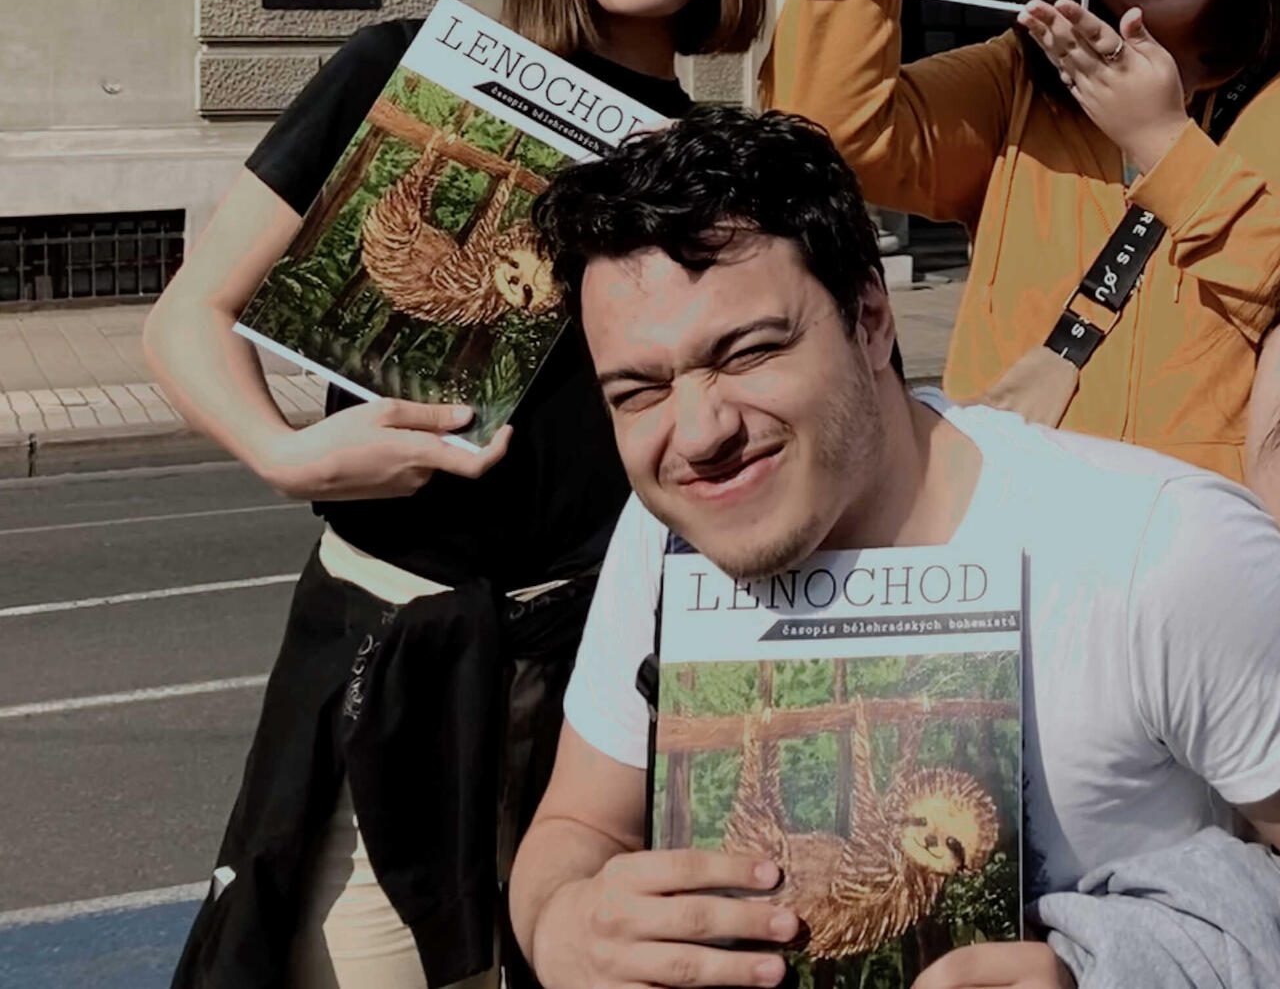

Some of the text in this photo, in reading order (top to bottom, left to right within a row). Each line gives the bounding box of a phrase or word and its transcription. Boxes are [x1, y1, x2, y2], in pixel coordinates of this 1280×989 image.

[1116, 243, 1135, 265] IS
[686, 564, 988, 611] LENOCHOD
[782, 614, 1017, 639] časopis bělehradských bohemistů
